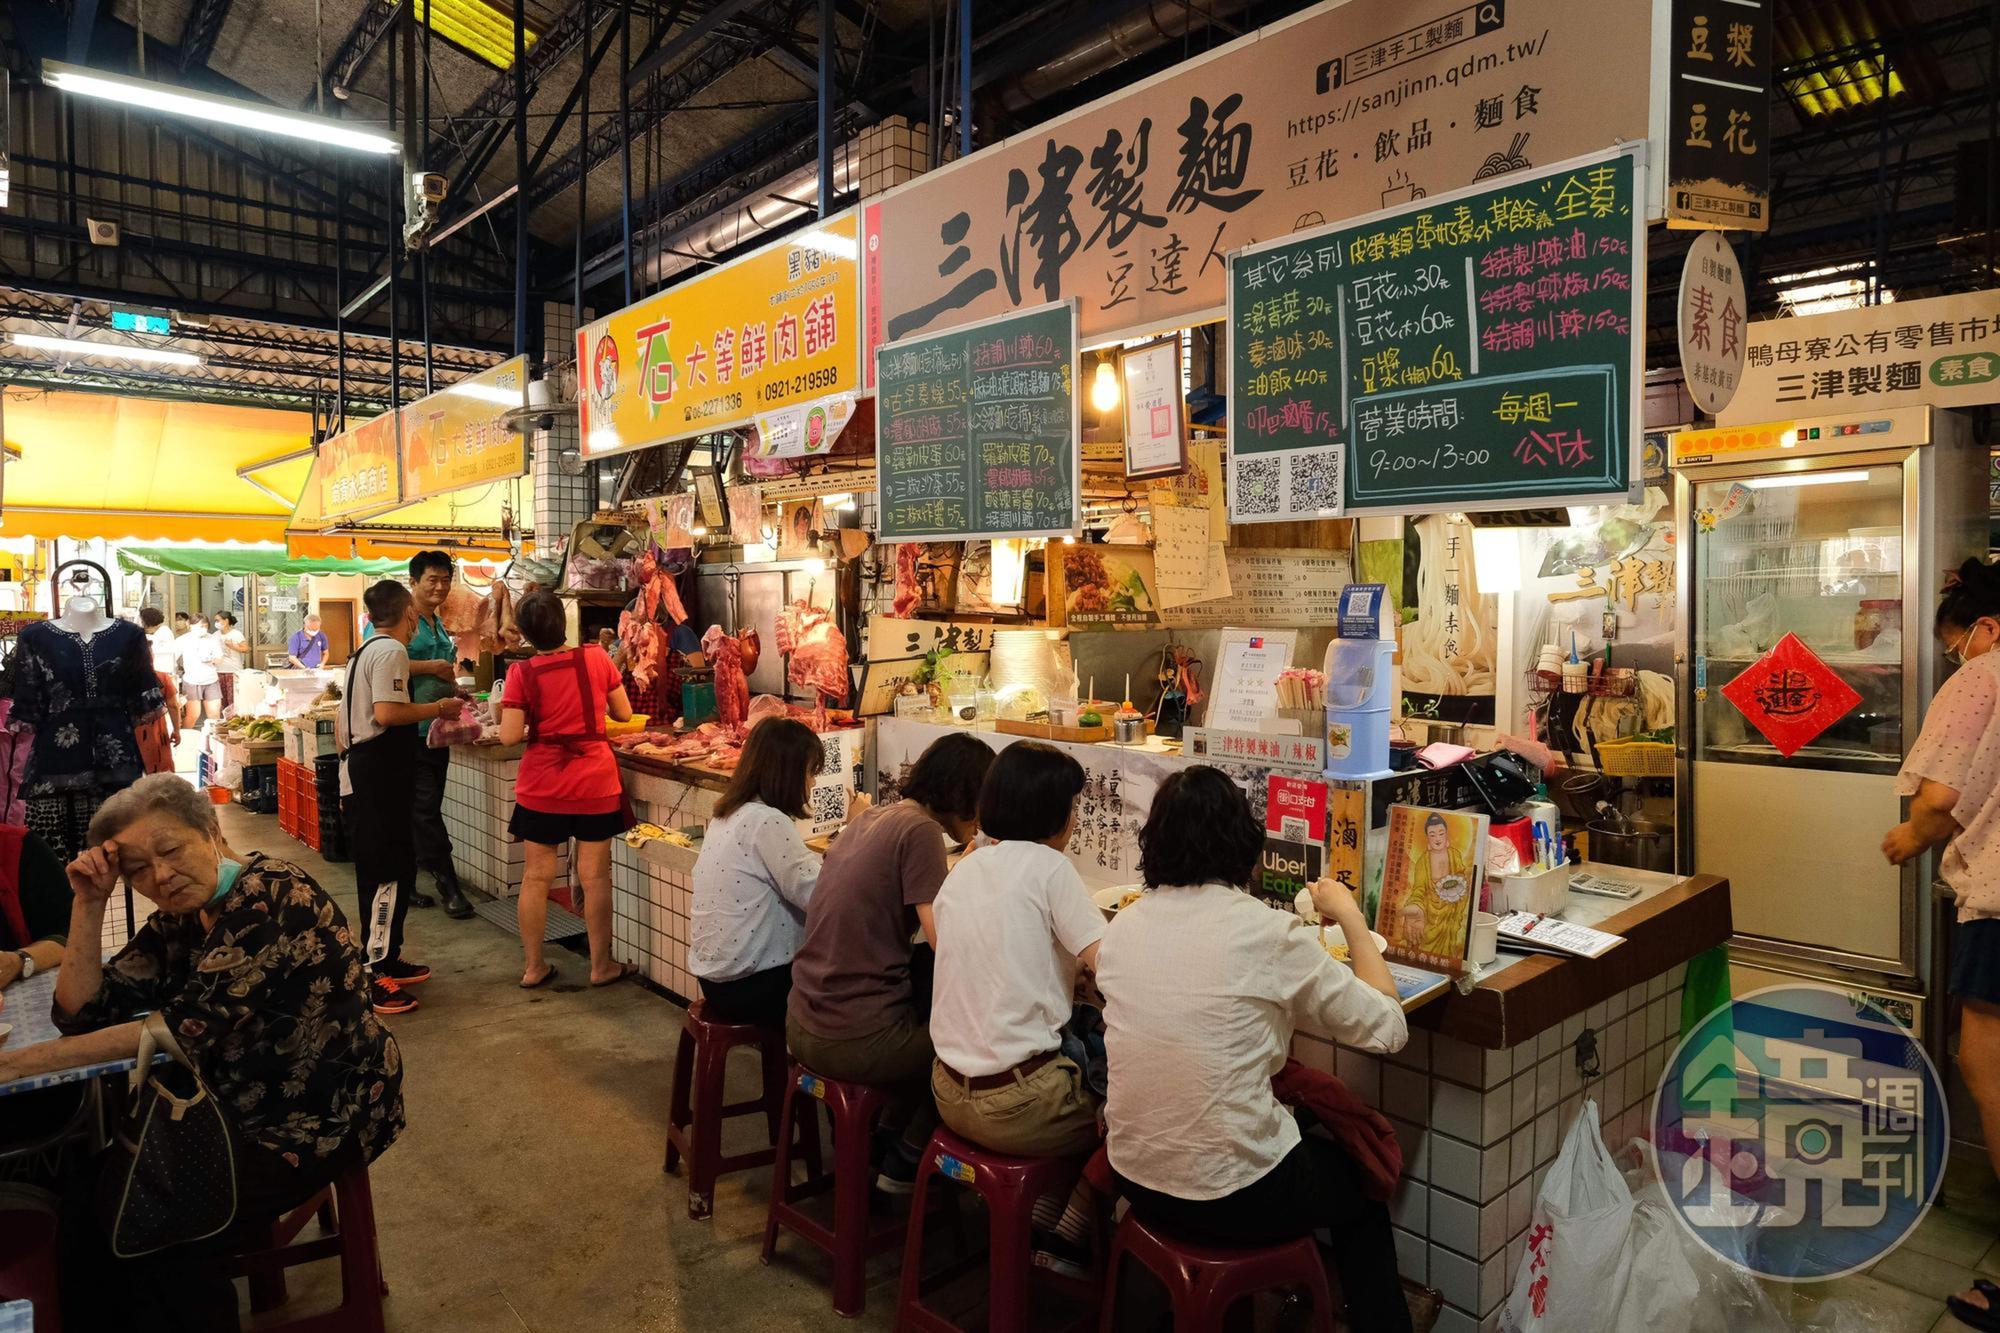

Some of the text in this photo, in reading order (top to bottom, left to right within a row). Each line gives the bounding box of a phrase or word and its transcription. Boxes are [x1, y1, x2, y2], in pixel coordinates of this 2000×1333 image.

[1352, 18, 1464, 77] 三津手工製麵
[1686, 15, 1756, 68] 豆漿
[1286, 29, 1549, 138] https://sanjinn.qdm.tw/
[1686, 103, 1758, 155] 豆花
[888, 93, 1265, 341] 三津製麵
[1099, 220, 1231, 311] 豆達人
[1306, 296, 1334, 317] 30元
[1687, 284, 1742, 361] 素食
[1308, 329, 1335, 350] 30元
[764, 365, 838, 401] 0921-219598
[1294, 367, 1328, 387] 40元
[1775, 355, 1994, 403] 三津製麵 素食
[1492, 390, 1579, 425] 每週一
[1512, 428, 1594, 469] 公休
[1262, 849, 1307, 877] Uber
